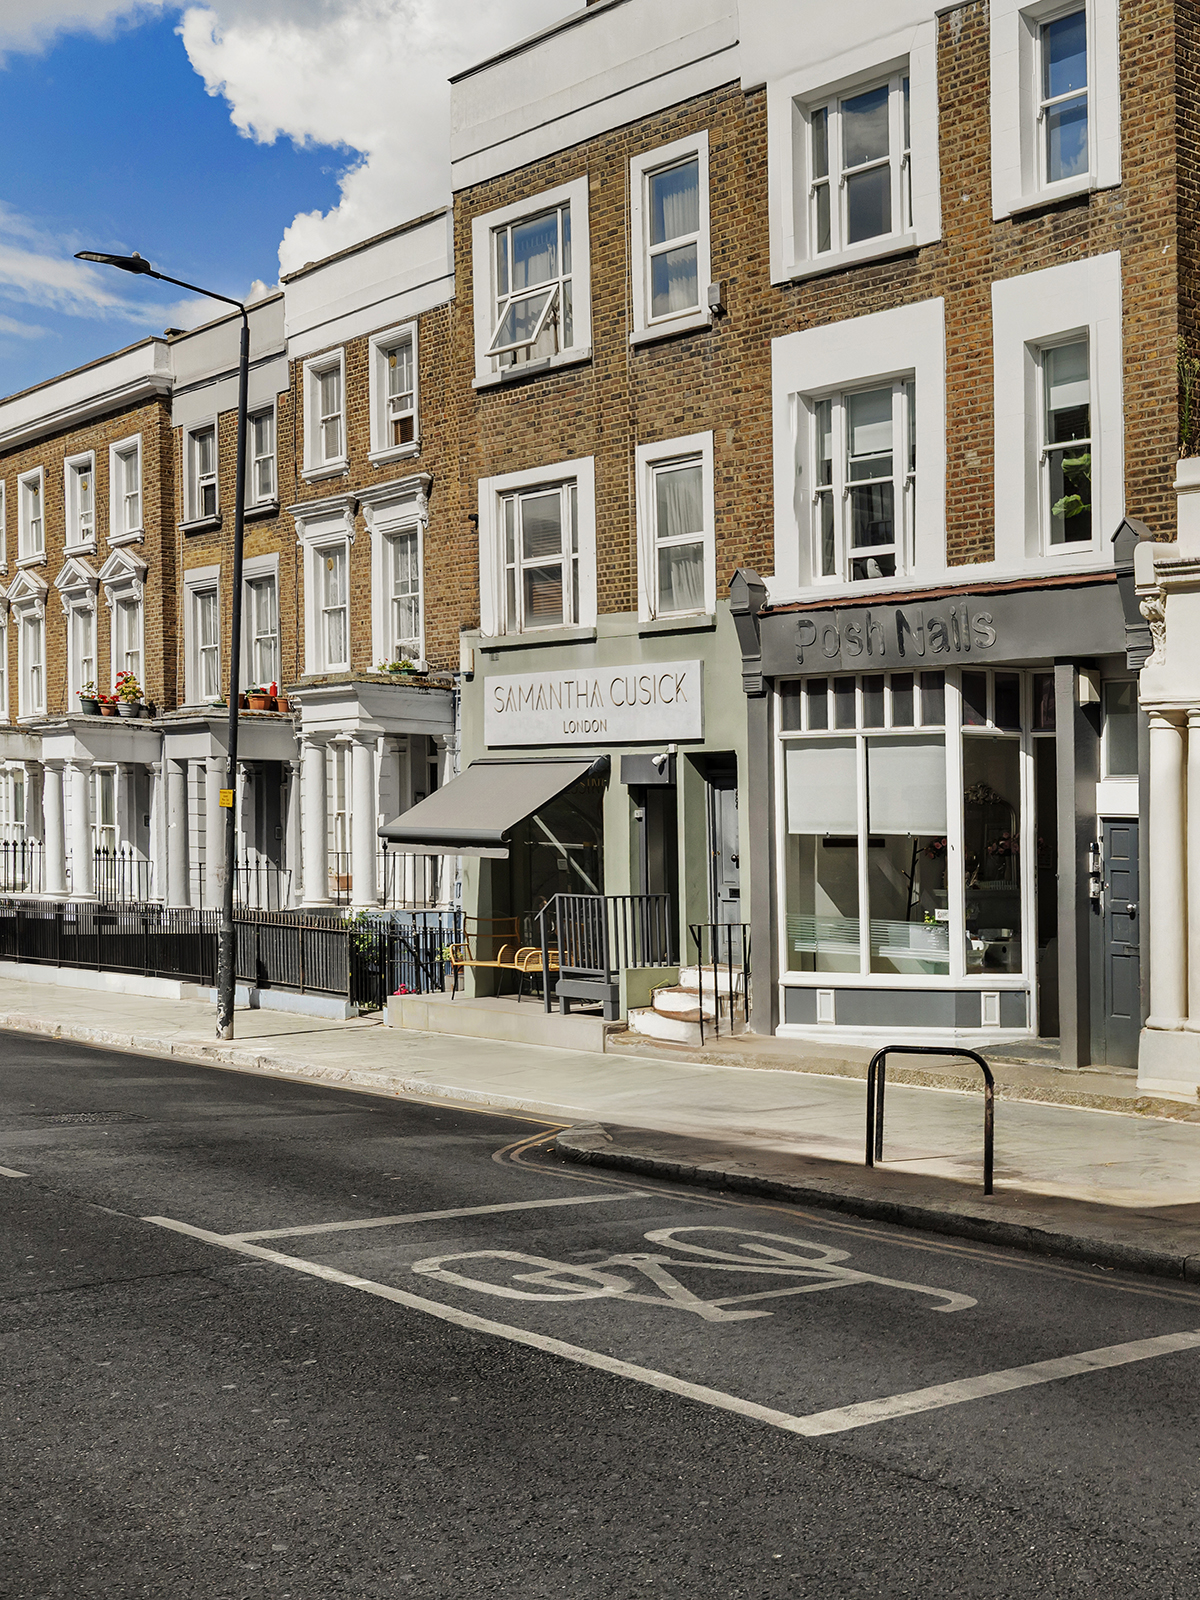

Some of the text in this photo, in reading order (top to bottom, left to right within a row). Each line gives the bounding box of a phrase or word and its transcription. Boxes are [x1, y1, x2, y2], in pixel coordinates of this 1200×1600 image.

[795, 601, 997, 665] Posh Nails
[493, 672, 688, 713] SAMANTHA CUSICK
[563, 719, 608, 734] LONDON
